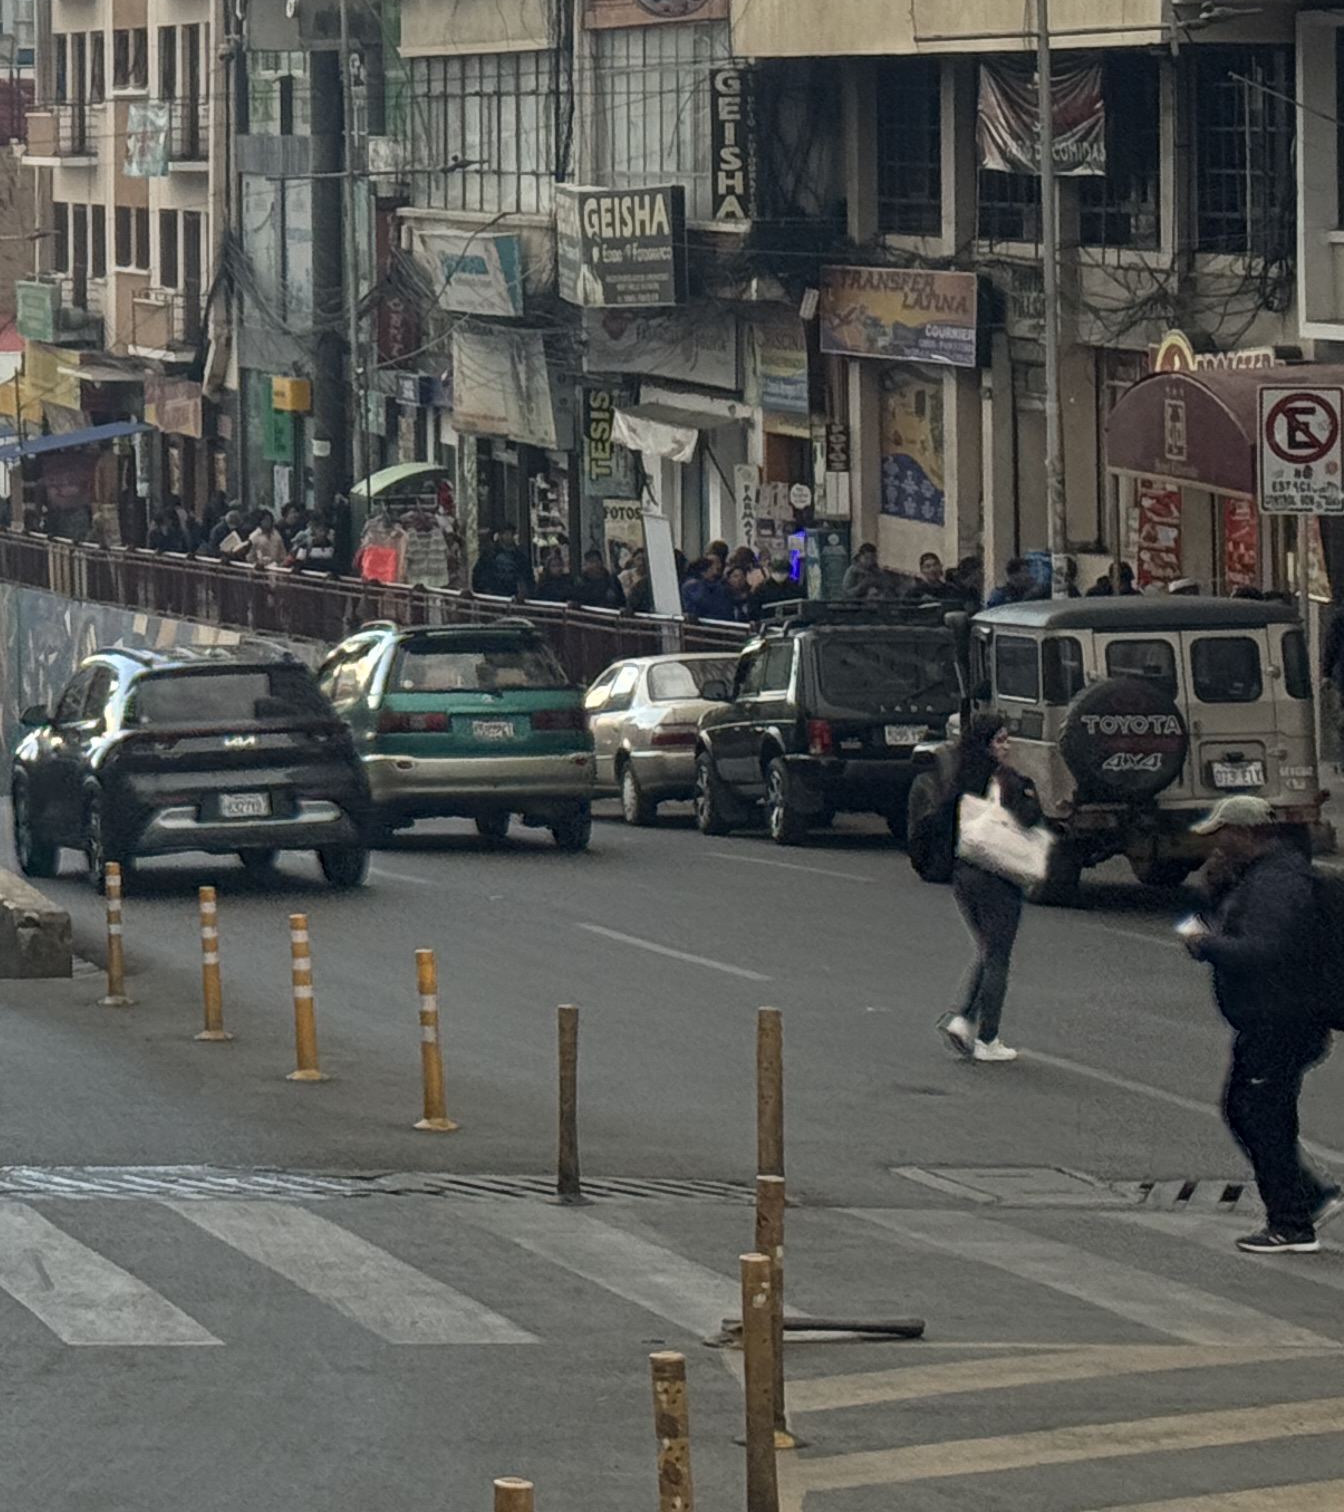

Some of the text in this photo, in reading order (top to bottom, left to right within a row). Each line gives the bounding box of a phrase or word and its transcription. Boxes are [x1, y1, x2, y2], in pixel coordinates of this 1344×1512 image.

[714, 71, 745, 221] GEISHA
[584, 194, 670, 239] GEISHA
[590, 390, 611, 481] TESIS
[604, 505, 642, 522] FOTOS
[742, 484, 757, 548] FARMACI
[1081, 715, 1183, 736] TOYOTA
